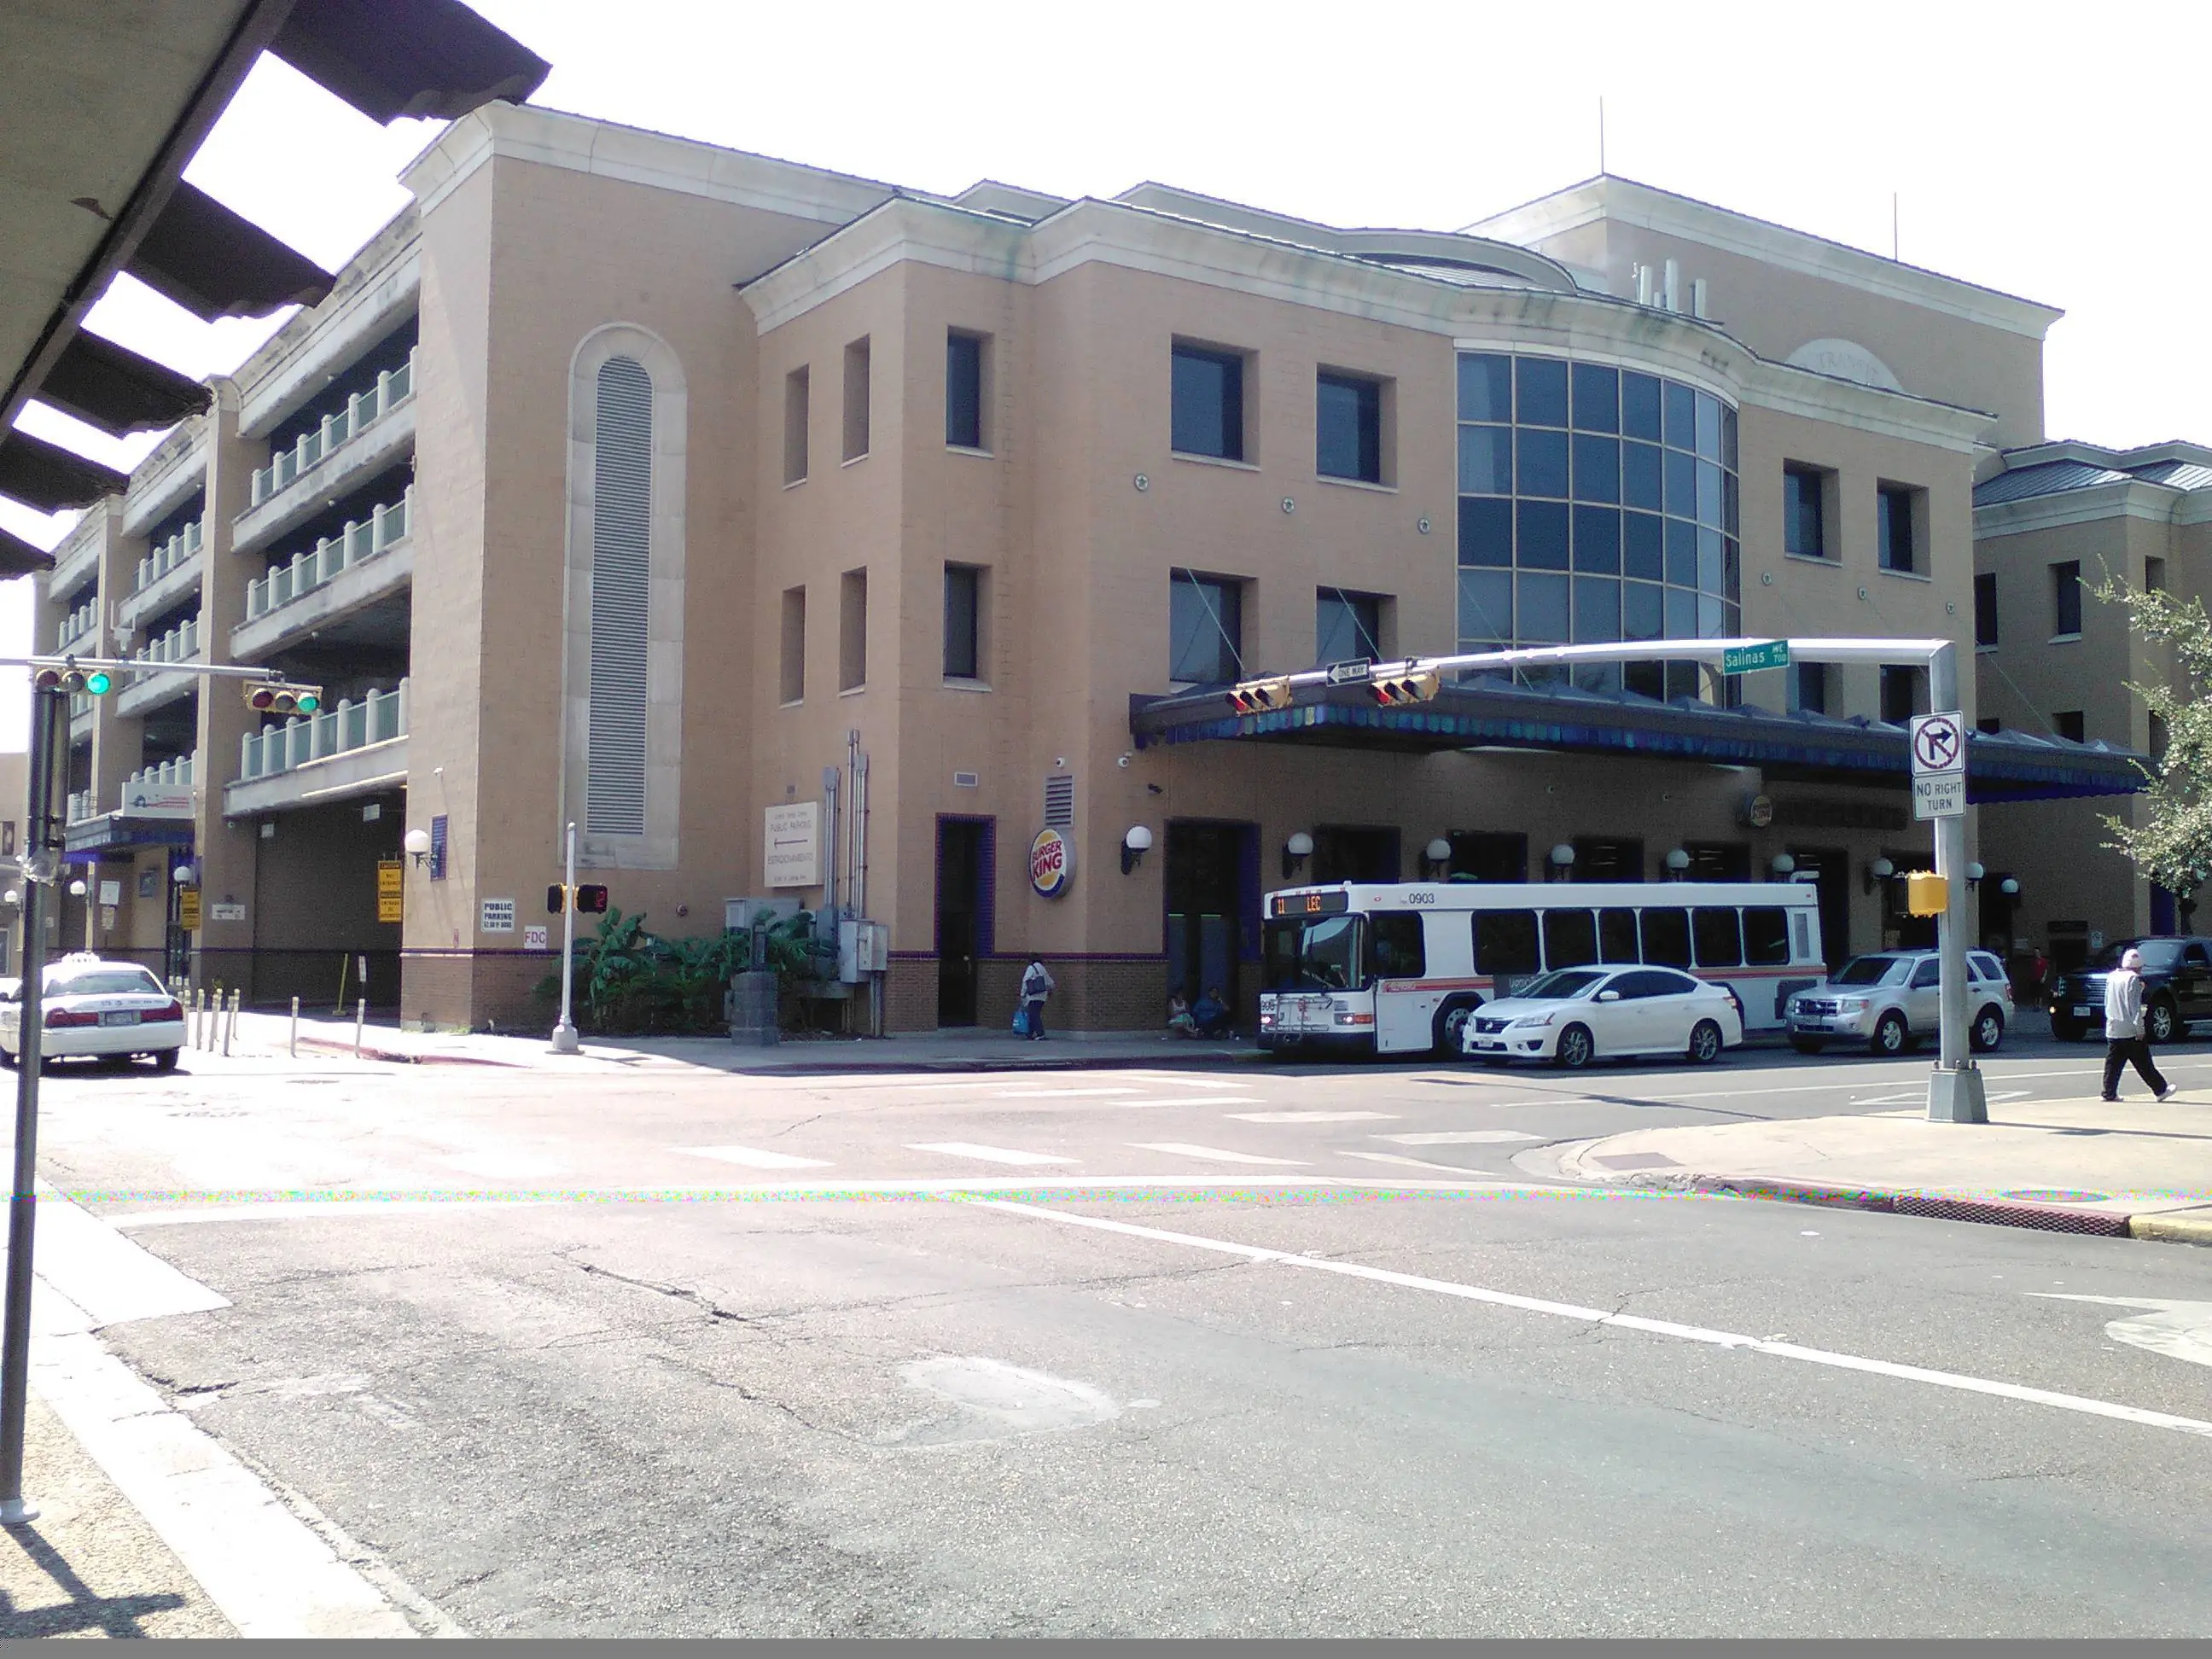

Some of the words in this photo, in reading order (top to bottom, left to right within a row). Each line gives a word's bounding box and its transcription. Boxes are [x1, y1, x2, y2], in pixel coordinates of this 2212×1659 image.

[1726, 649, 1765, 667] Salinas
[1338, 667, 1350, 678] ONE
[1352, 665, 1365, 676] WAY
[1917, 783, 1931, 797] NO
[1935, 782, 1962, 795] RIGHT
[1926, 799, 1953, 811] TURN
[1032, 840, 1062, 864] BURGER
[1033, 853, 1062, 879] KING
[1307, 895, 1322, 912] LEC
[1408, 893, 1435, 905] 0903
[484, 912, 513, 921] PARKING
[525, 931, 546, 944] FDC
